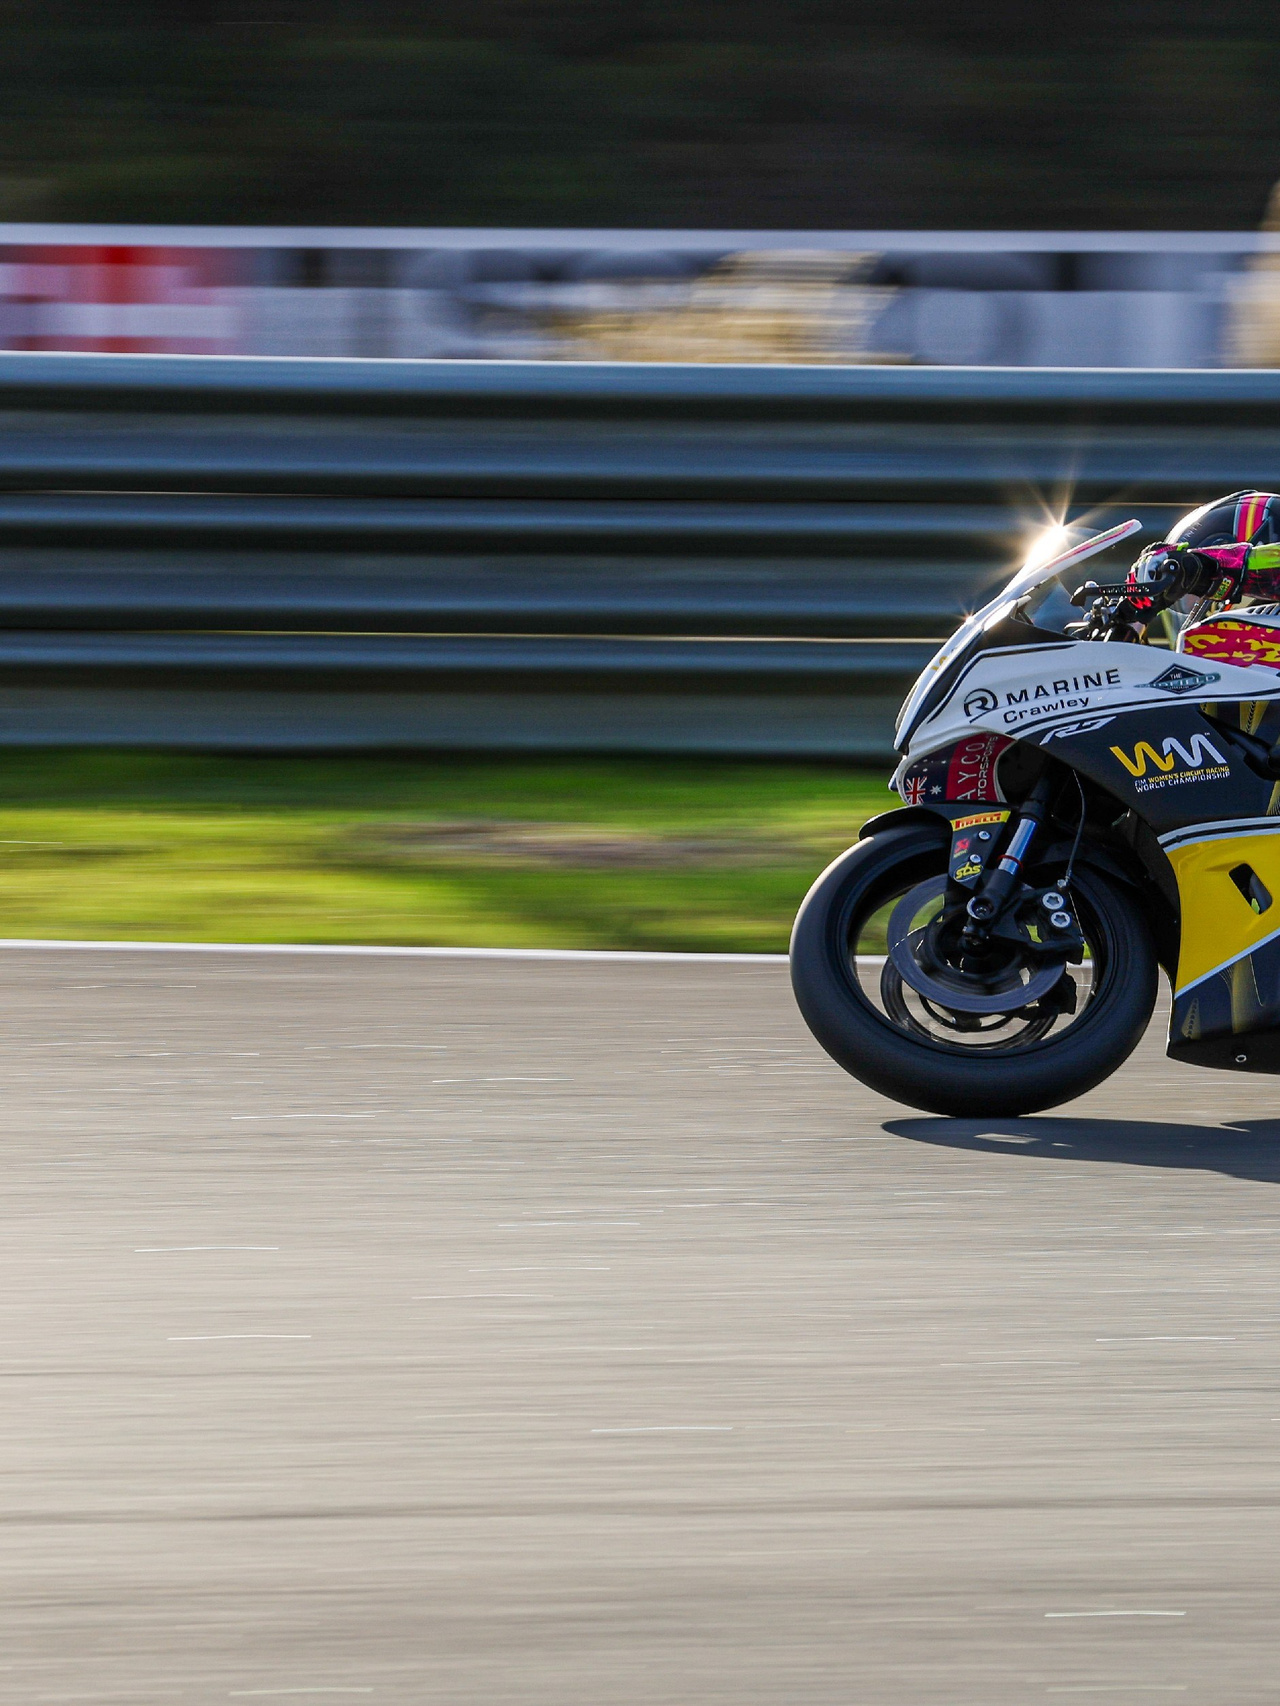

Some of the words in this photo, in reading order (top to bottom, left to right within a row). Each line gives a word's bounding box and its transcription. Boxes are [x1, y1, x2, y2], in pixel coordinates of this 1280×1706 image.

[1006, 668, 1121, 706] MARINE
[1003, 697, 1089, 723] Crawley
[1135, 781, 1166, 793] WORLD
[1168, 771, 1231, 787] CHAMPIONSHIP
[1147, 773, 1179, 783] WOMEN'S
[1179, 769, 1204, 779] CIRCUIT
[1205, 765, 1230, 774] RACING
